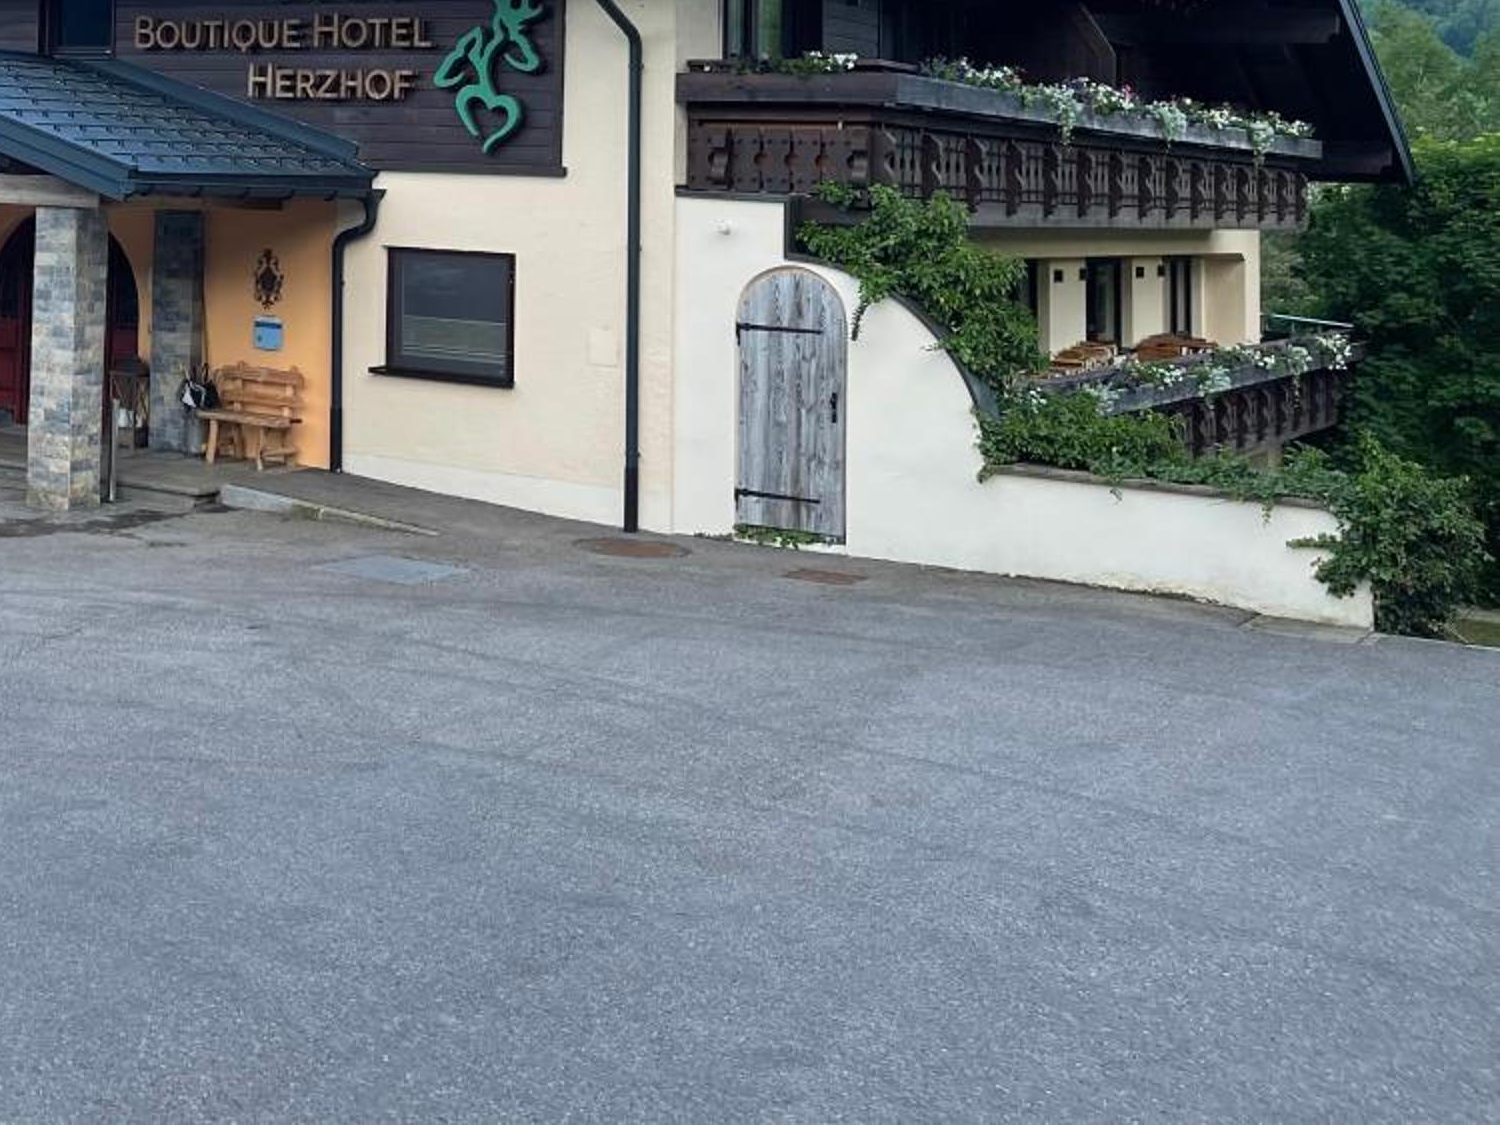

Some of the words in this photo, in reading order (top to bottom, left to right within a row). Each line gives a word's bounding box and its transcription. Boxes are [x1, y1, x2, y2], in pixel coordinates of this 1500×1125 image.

[134, 16, 301, 52] BOUTIQUE
[312, 12, 432, 48] HOTEL
[247, 62, 413, 100] HERZHOF
